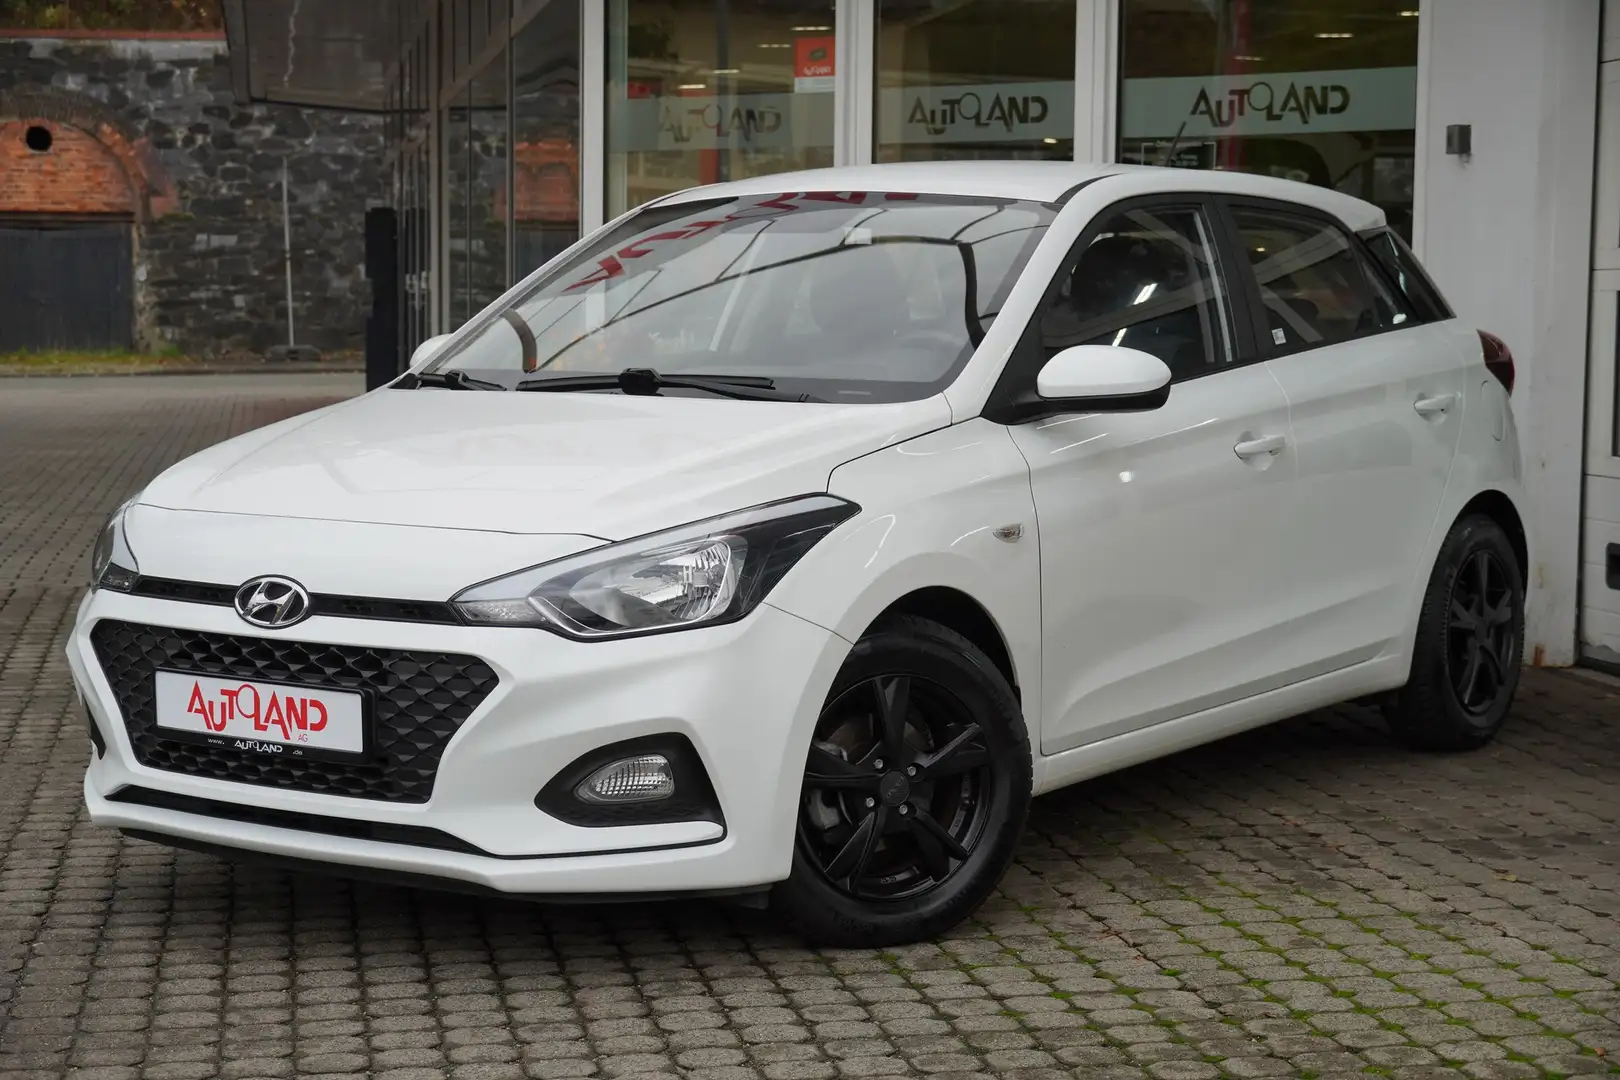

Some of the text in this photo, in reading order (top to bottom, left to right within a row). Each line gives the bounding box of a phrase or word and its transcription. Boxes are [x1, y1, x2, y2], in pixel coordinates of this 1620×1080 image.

[908, 92, 1048, 136] AUTOLAND
[1190, 82, 1351, 128] AUTOLAND
[187, 680, 328, 740] AUTOLAND
[234, 740, 283, 753] AUTOLAND
[297, 733, 309, 743] AG
